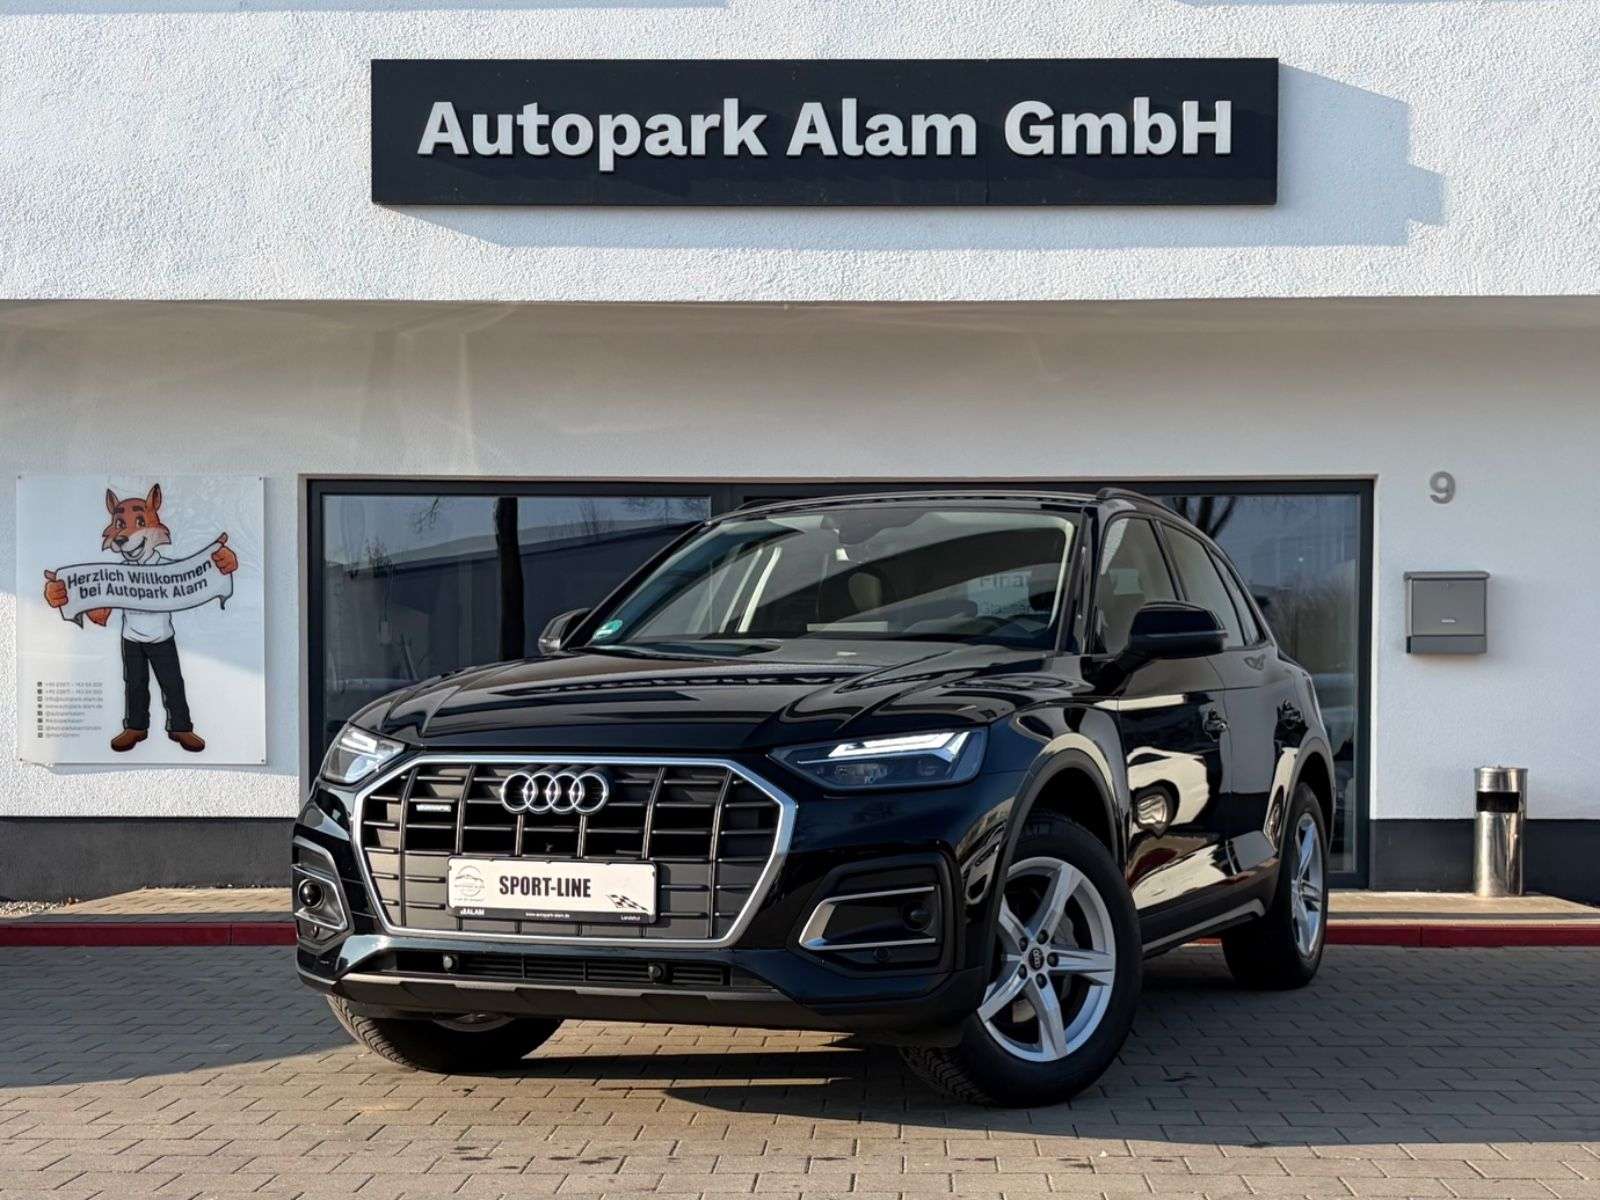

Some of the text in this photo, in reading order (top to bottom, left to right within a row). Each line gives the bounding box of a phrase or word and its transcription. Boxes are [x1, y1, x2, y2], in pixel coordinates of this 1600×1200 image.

[418, 97, 1232, 171] Autopark Alam GmbH
[1429, 471, 1456, 504] 9
[66, 560, 212, 589] Herzlich Willkommen
[79, 577, 208, 600] bei Autopark Alam
[499, 875, 591, 898] SPORT-LINE
